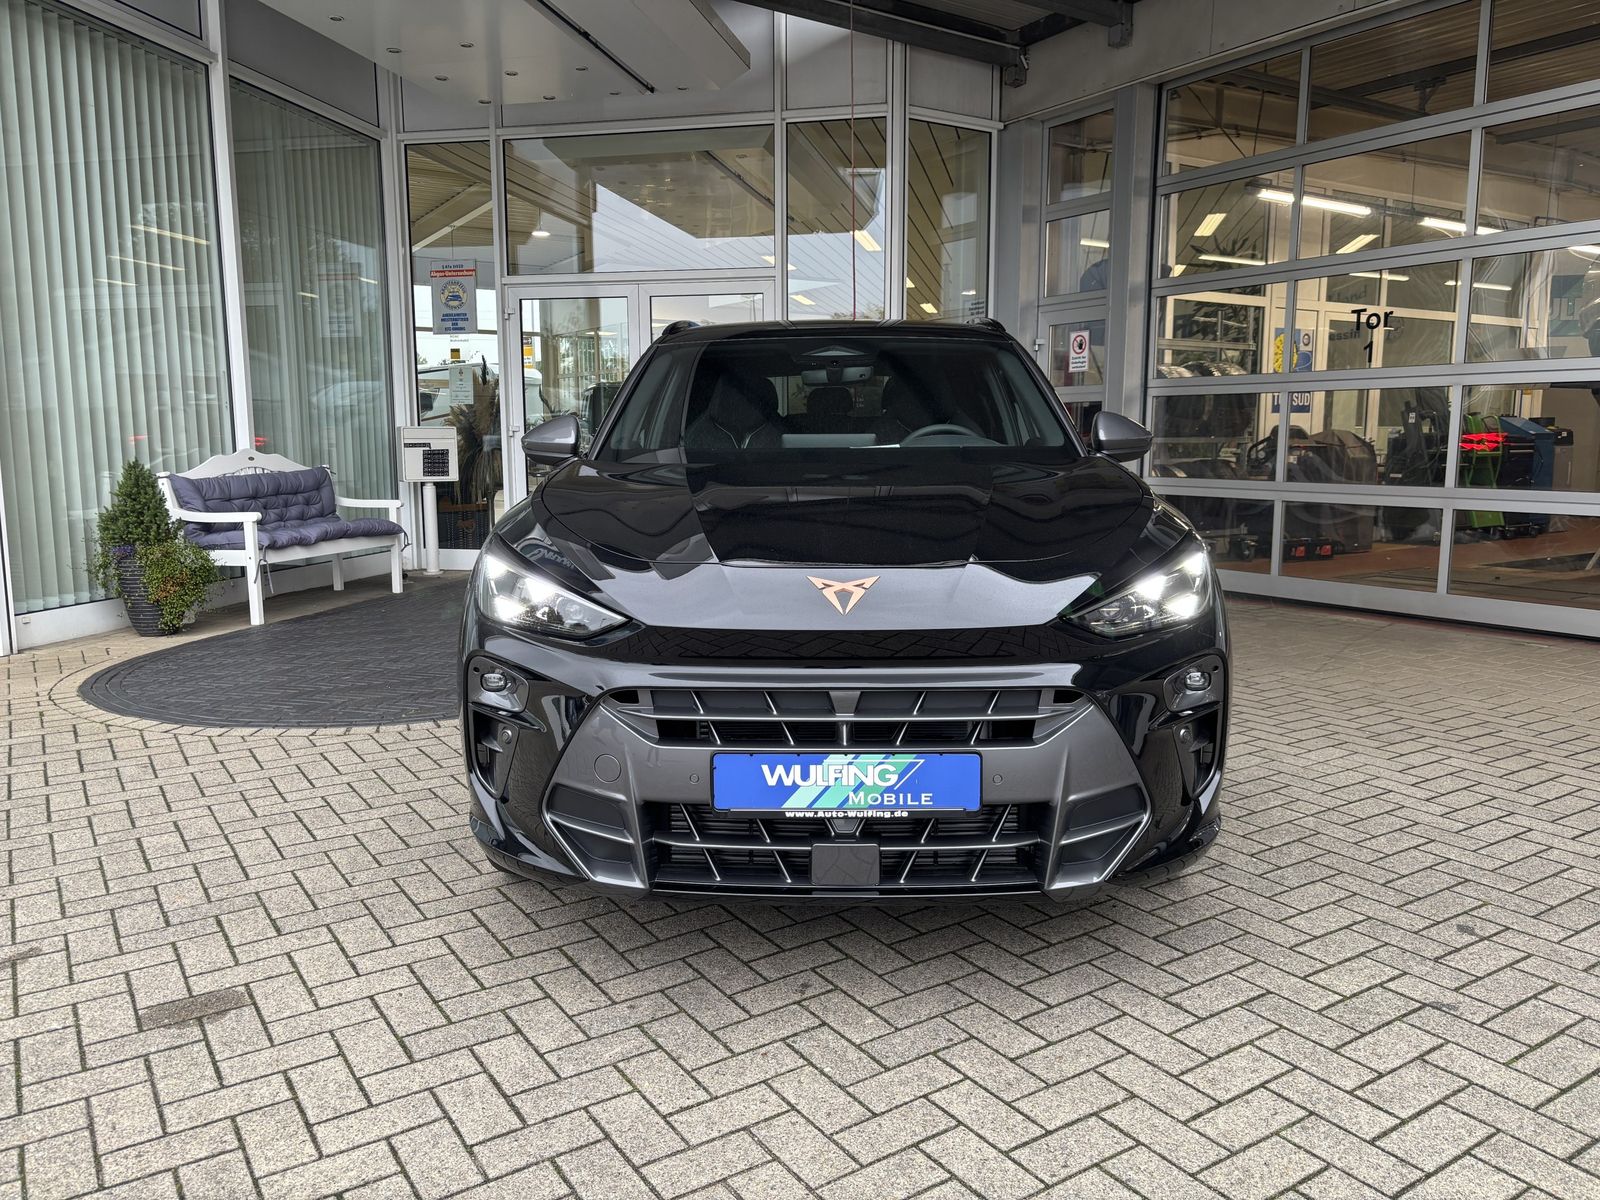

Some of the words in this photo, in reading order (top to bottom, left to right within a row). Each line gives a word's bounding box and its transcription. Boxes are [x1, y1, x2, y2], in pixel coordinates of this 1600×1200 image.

[1351, 308, 1394, 331] Tor
[1363, 340, 1374, 363] 1
[761, 764, 898, 787] WULFING
[848, 791, 933, 805] MOBILE
[785, 810, 909, 818] www.Auto-Wulfing.de
